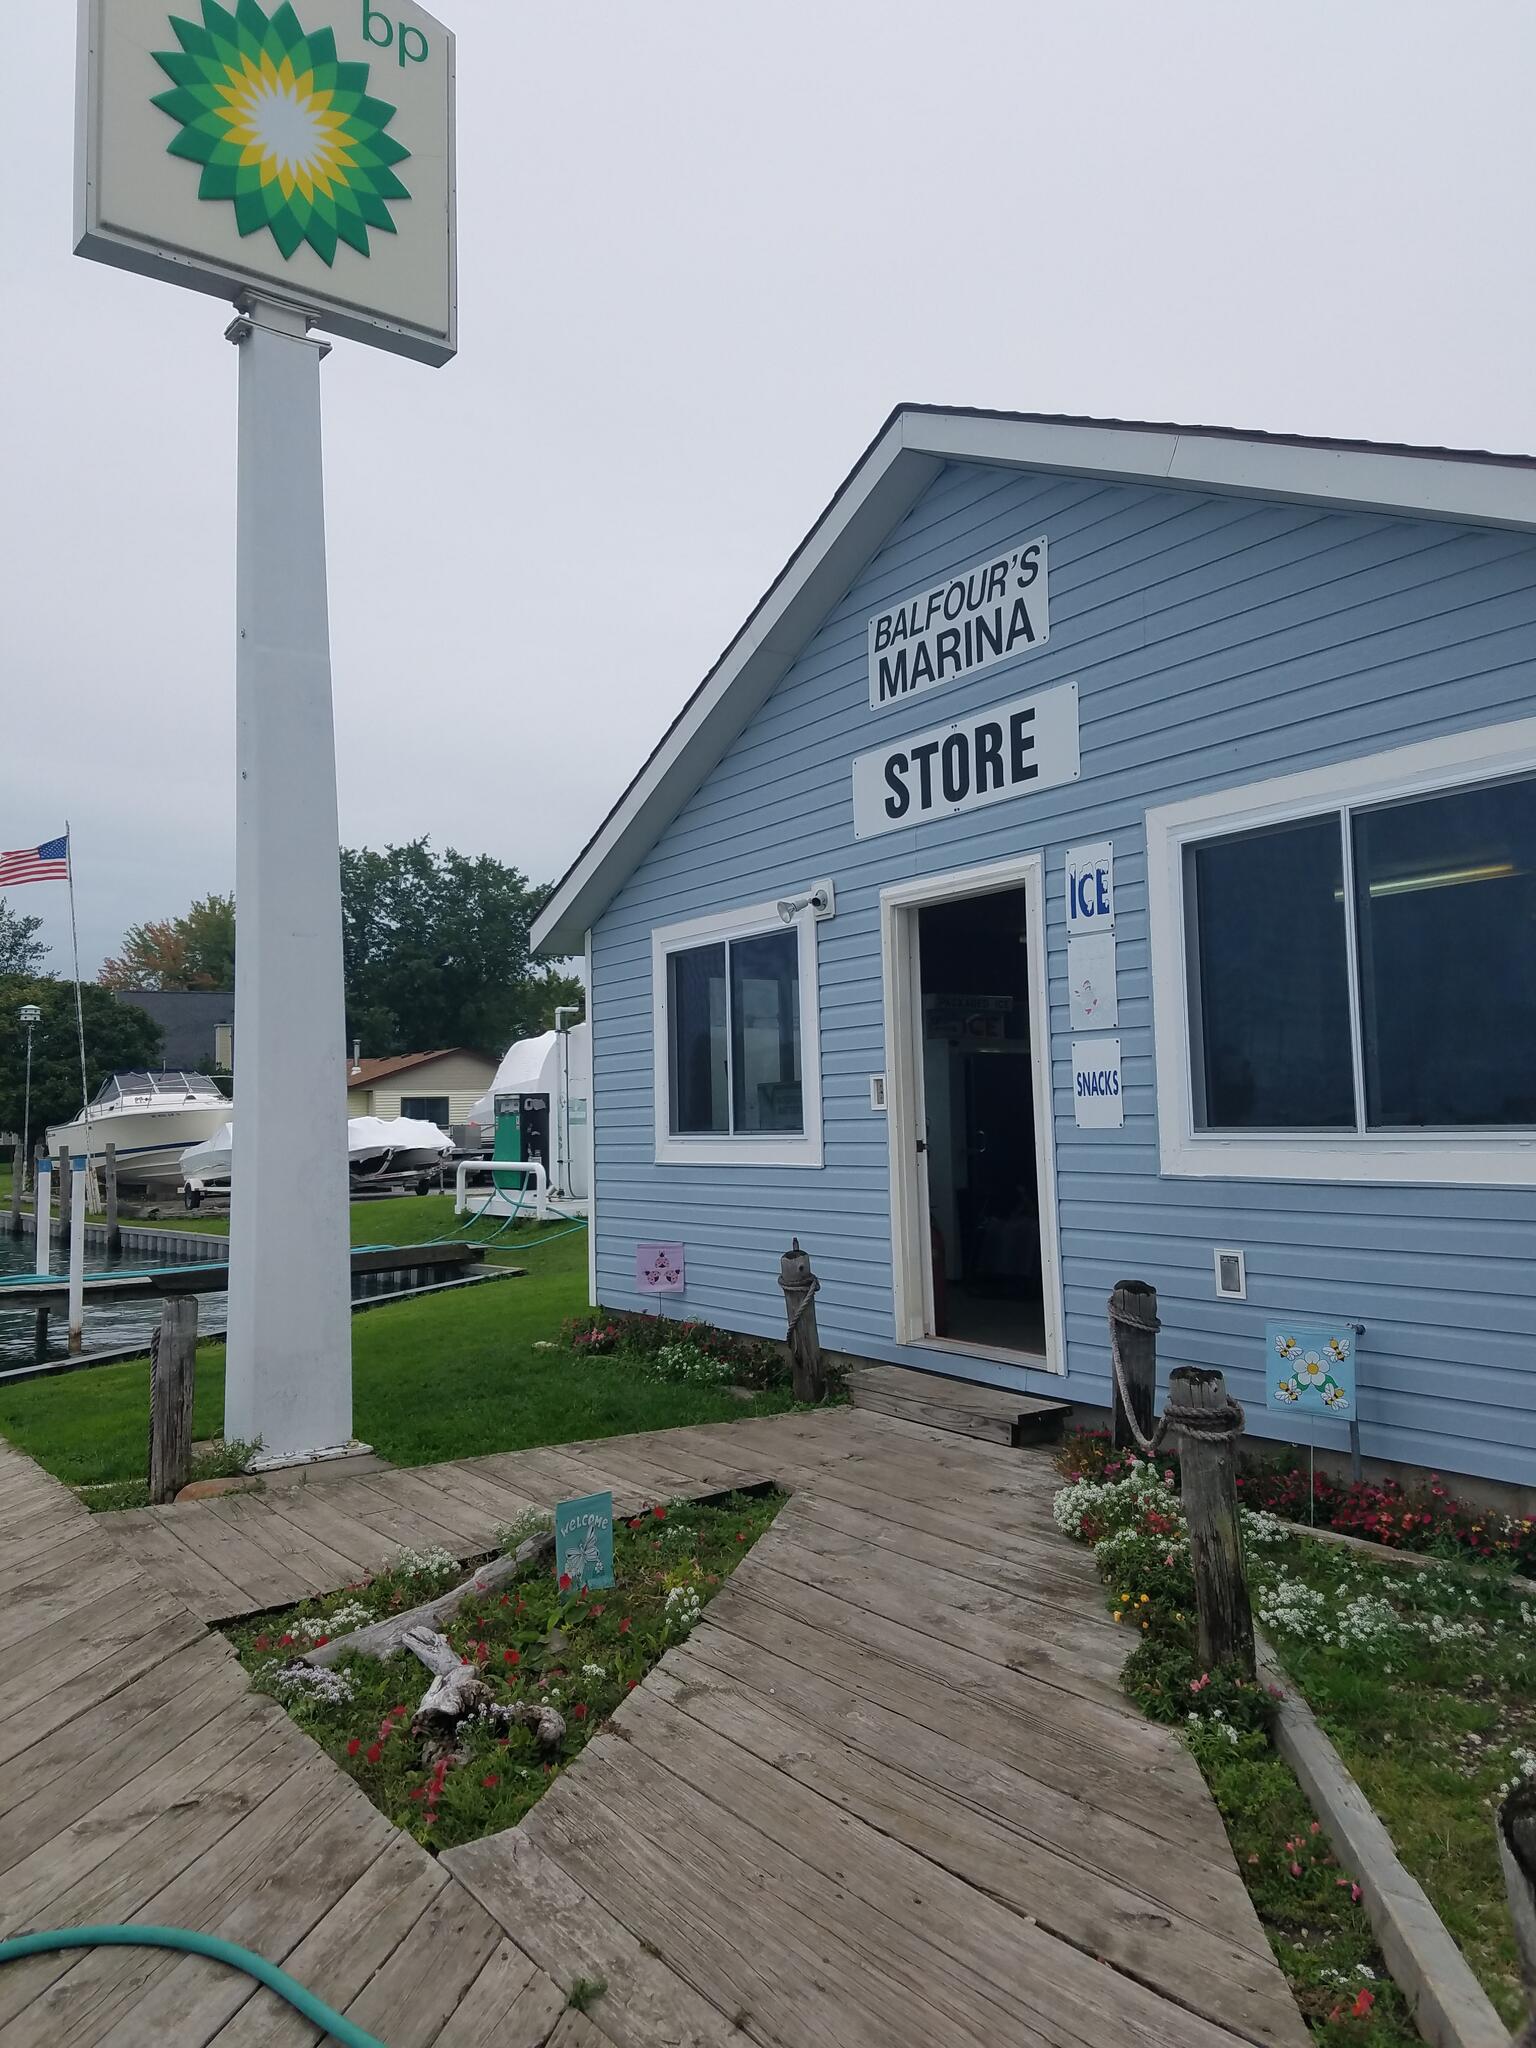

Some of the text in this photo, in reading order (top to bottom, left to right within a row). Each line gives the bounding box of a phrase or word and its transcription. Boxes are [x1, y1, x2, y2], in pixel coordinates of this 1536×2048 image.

[363, 0, 428, 68] bp
[874, 544, 1041, 653] BALFOUR'S
[878, 597, 1036, 702] MARINA
[884, 707, 1039, 819] STORE
[1069, 859, 1110, 919] ICE
[1076, 1070, 1119, 1097] SNACKS
